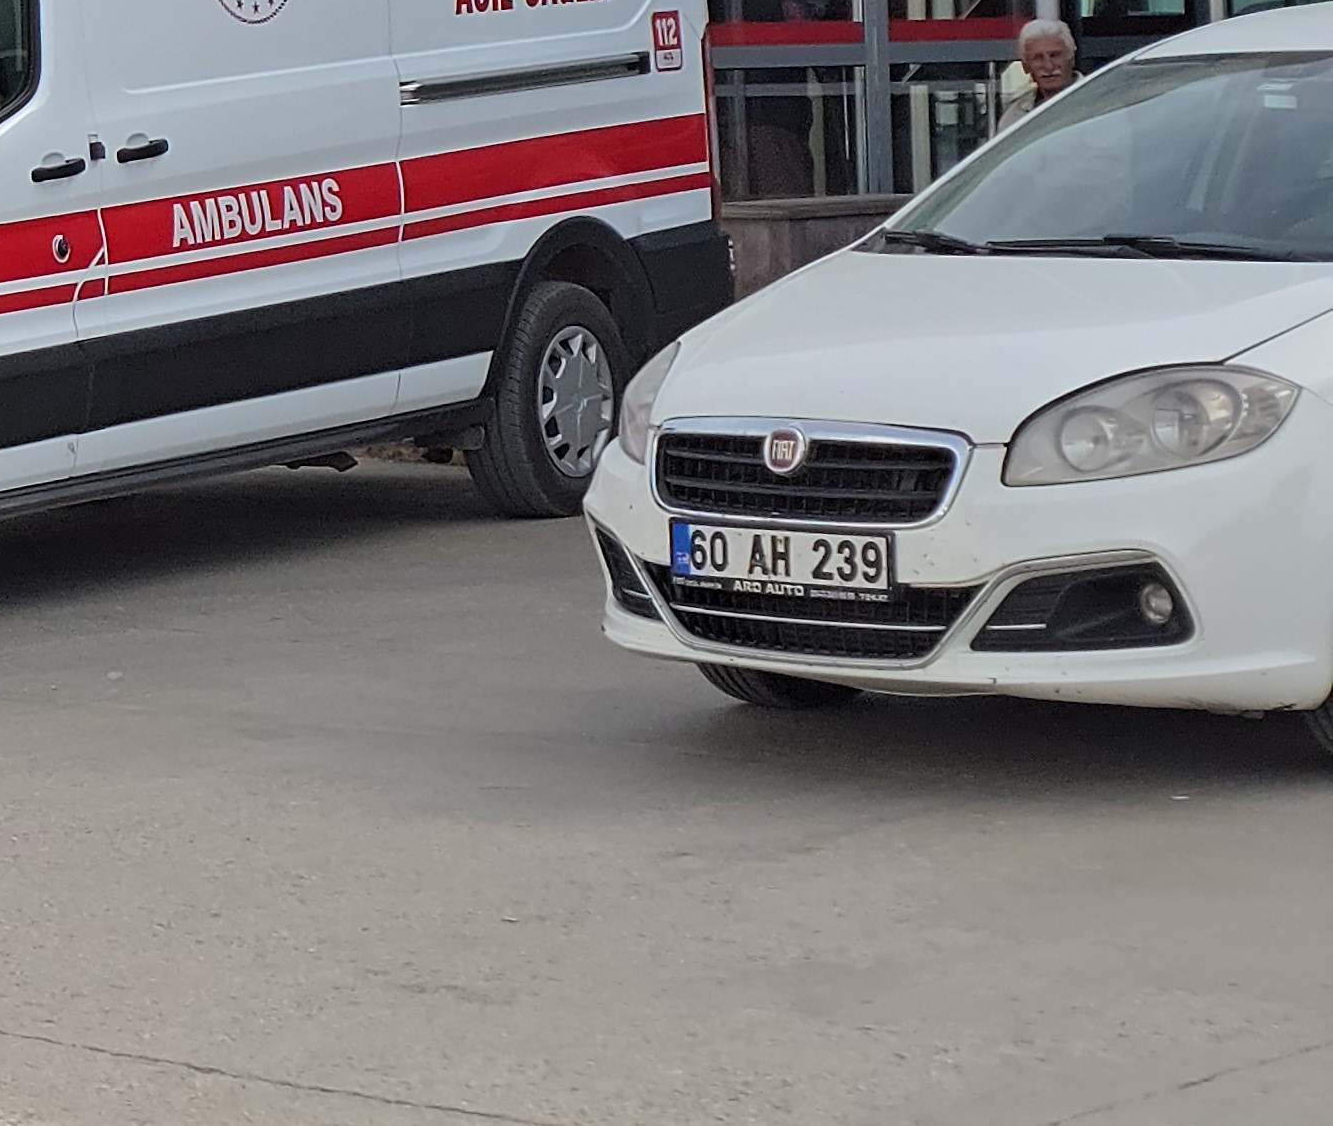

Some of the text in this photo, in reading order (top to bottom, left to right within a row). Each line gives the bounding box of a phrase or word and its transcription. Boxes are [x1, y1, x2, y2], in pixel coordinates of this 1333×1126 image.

[655, 17, 678, 46] 112
[172, 178, 343, 248] AMBULANS
[771, 439, 797, 460] FIAT
[690, 529, 883, 584] 60 AH 239
[765, 582, 805, 596] AUTO
